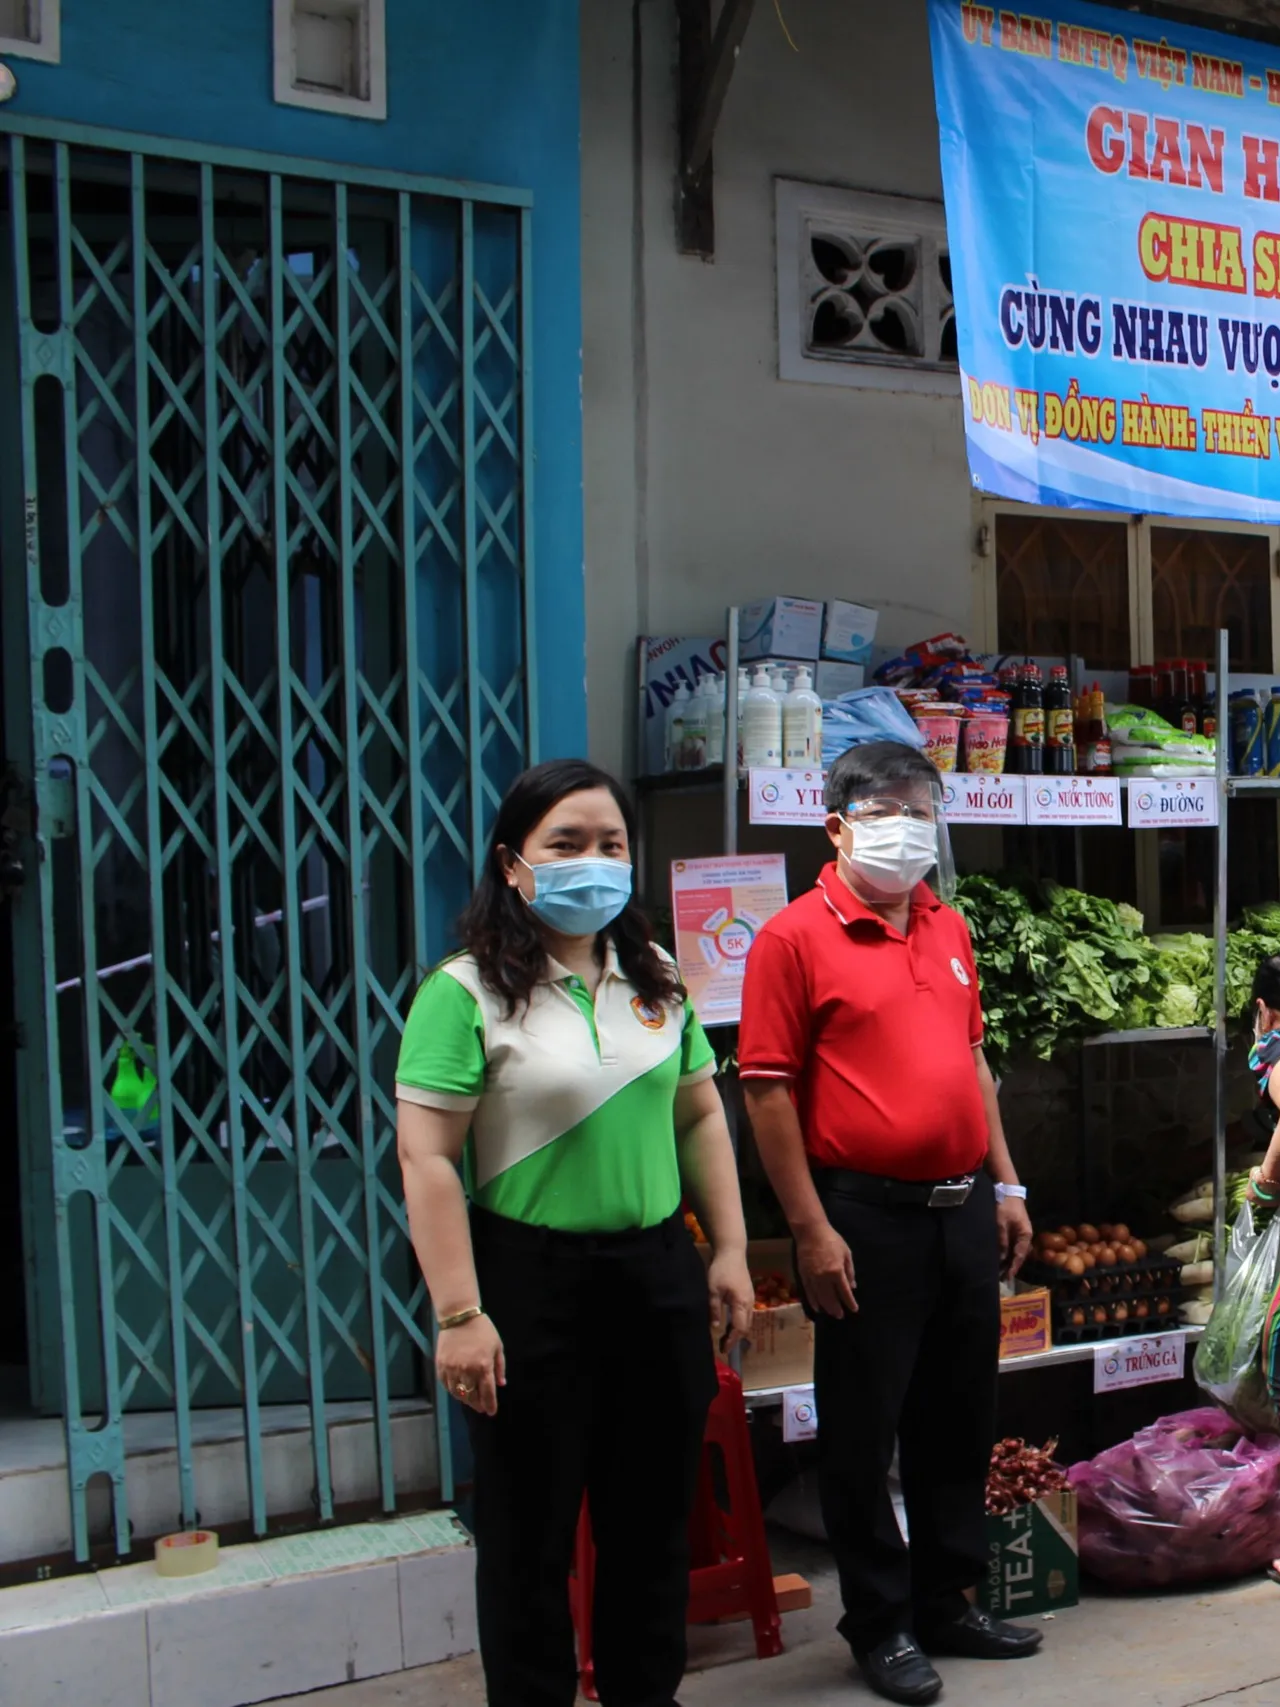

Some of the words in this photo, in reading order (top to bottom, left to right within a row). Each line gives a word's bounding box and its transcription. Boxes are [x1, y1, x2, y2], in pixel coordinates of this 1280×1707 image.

[999, 9, 1052, 58] BAN
[1057, 22, 1128, 83] MTTQ
[1132, 37, 1188, 90] VIỆT
[1192, 54, 1243, 96] NAM
[1087, 105, 1225, 194] GIAN
[1138, 211, 1247, 294] CHIA
[1000, 280, 1101, 354] CÙNG
[1112, 303, 1208, 367] NHAU
[968, 376, 1012, 432] ĐƠN
[1014, 388, 1039, 446] VỊ
[1044, 378, 1117, 444] ĐỒNG
[1122, 393, 1197, 451] HÀNH:
[1202, 398, 1270, 459] THIỀN
[796, 788, 806, 806] Y
[966, 787, 984, 809] MÌ
[987, 787, 1013, 809] GÓI
[1058, 785, 1082, 808] NƯỚC
[1084, 791, 1114, 808] TƯƠNG
[1161, 792, 1204, 813] ĐƯỜNG
[727, 937, 745, 950] 5K
[1125, 1350, 1160, 1372] TRỨNG
[1162, 1345, 1178, 1366] GÀ
